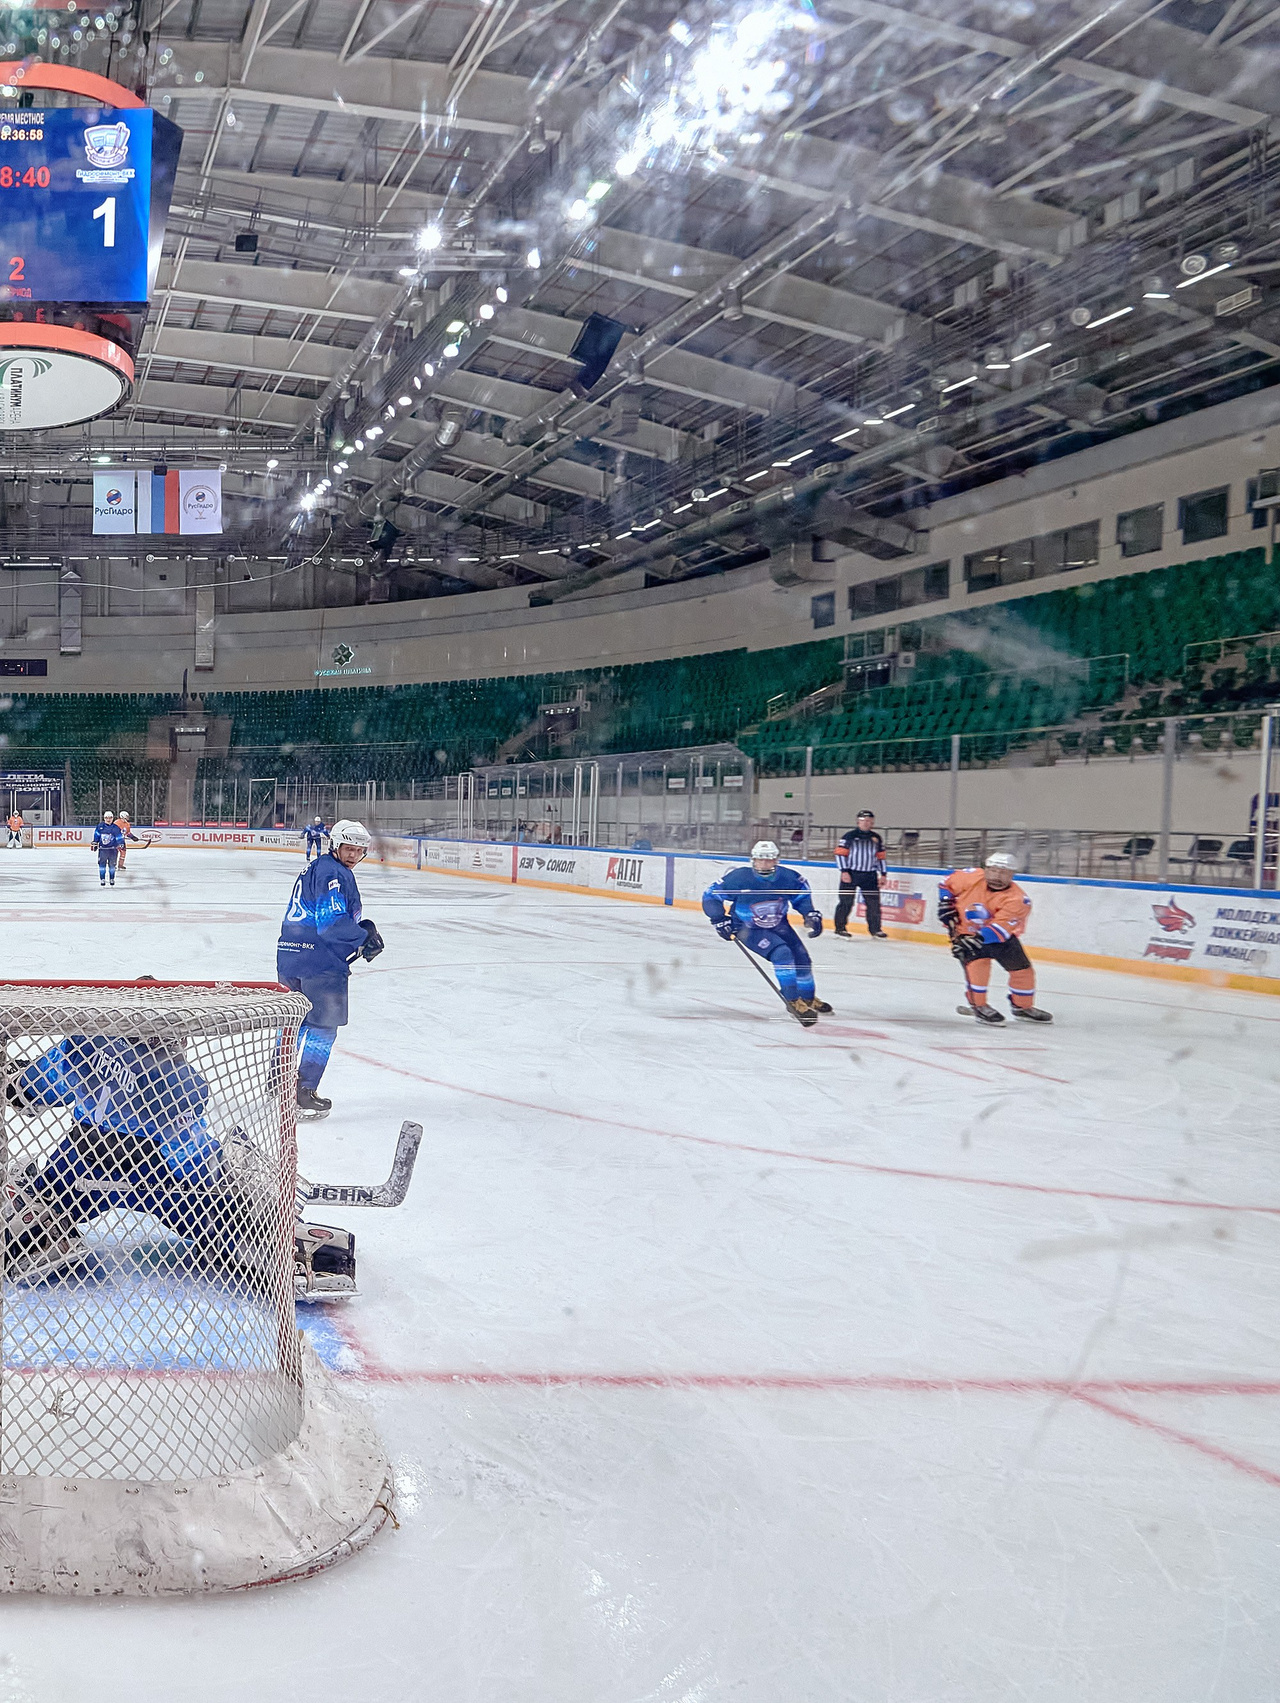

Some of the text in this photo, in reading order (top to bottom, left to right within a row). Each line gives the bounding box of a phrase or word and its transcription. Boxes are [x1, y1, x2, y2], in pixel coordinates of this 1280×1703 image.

[15, 113, 45, 124] МЕСТНОЕ
[92, 196, 116, 247] 1
[9, 256, 25, 281] 2
[95, 507, 133, 516] РусГидро
[38, 830, 83, 841] FHR.RU
[191, 832, 256, 843] OLIMPBET
[546, 858, 576, 873] СОКОЛ!
[617, 858, 644, 883] АГАТ
